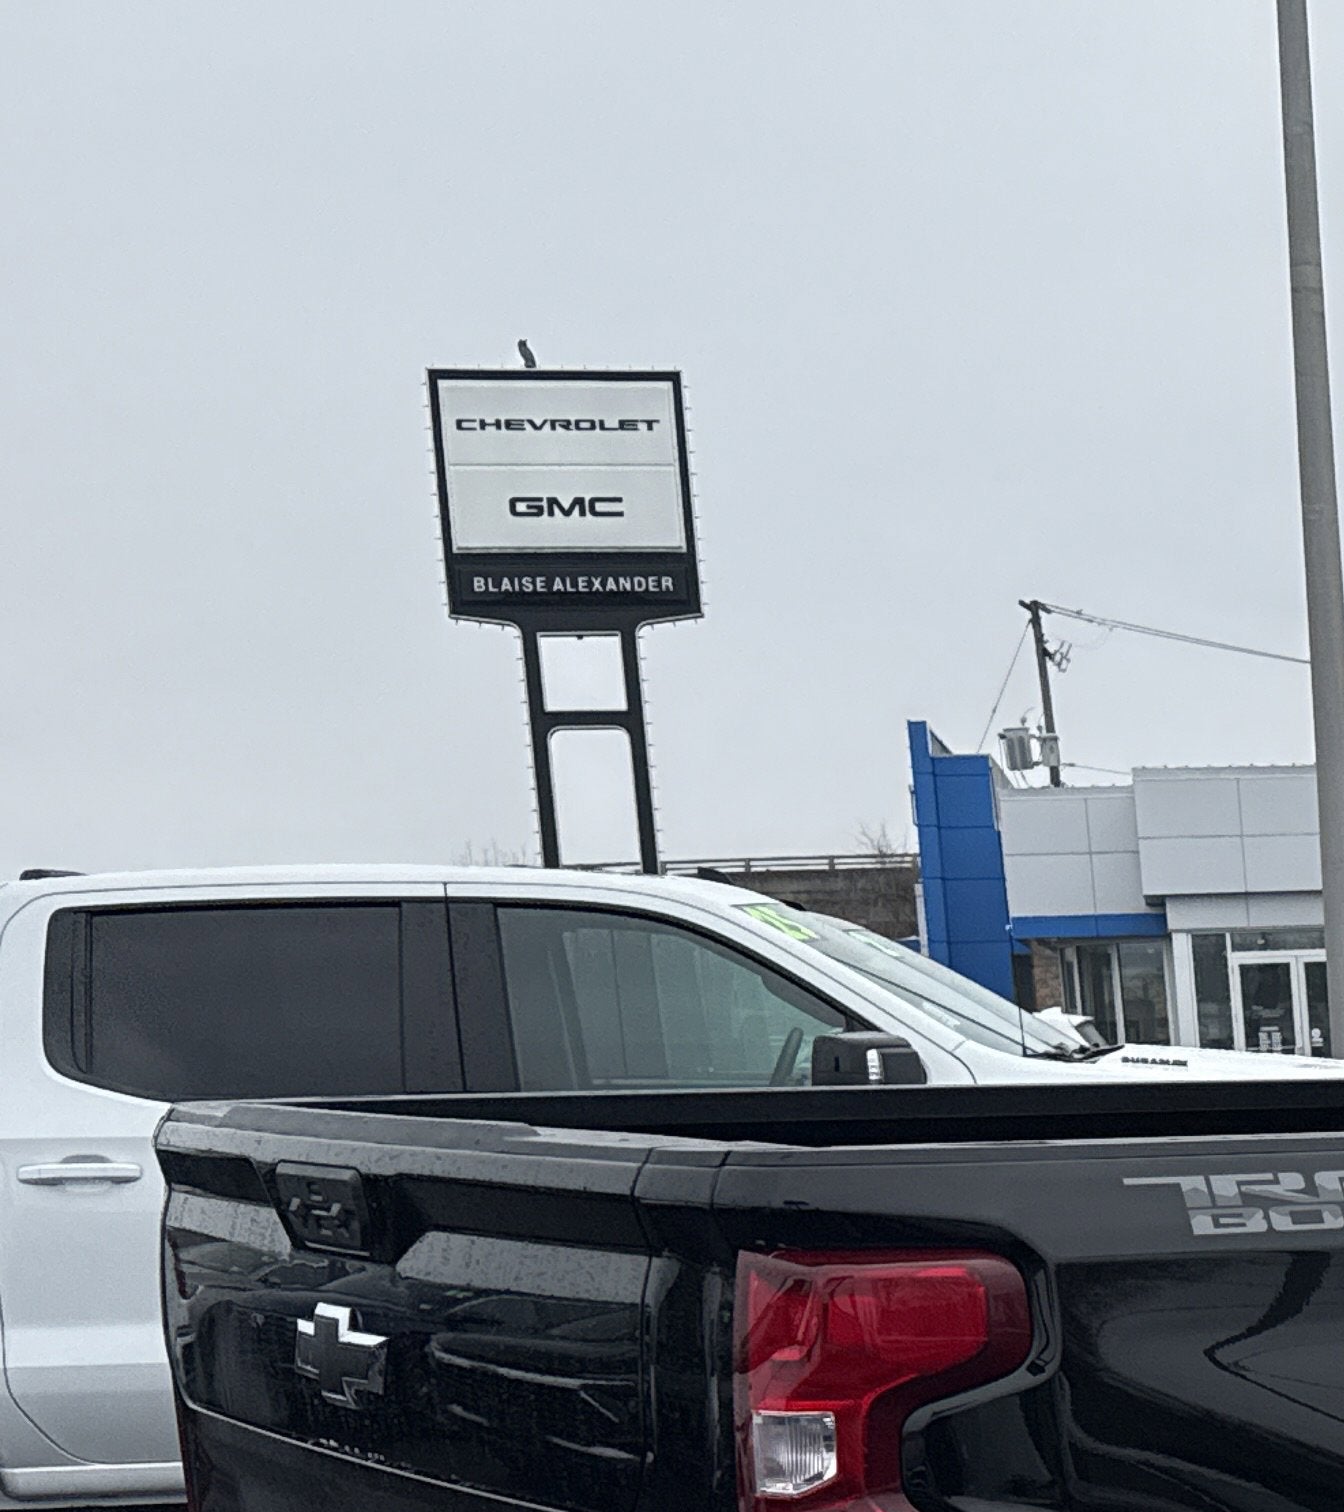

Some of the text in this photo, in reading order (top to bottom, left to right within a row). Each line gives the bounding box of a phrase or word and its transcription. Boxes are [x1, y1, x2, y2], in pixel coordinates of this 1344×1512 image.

[455, 417, 661, 432] CHEVROLET
[508, 496, 625, 518] GMC
[472, 575, 674, 593] BLAISE ALEXANDER
